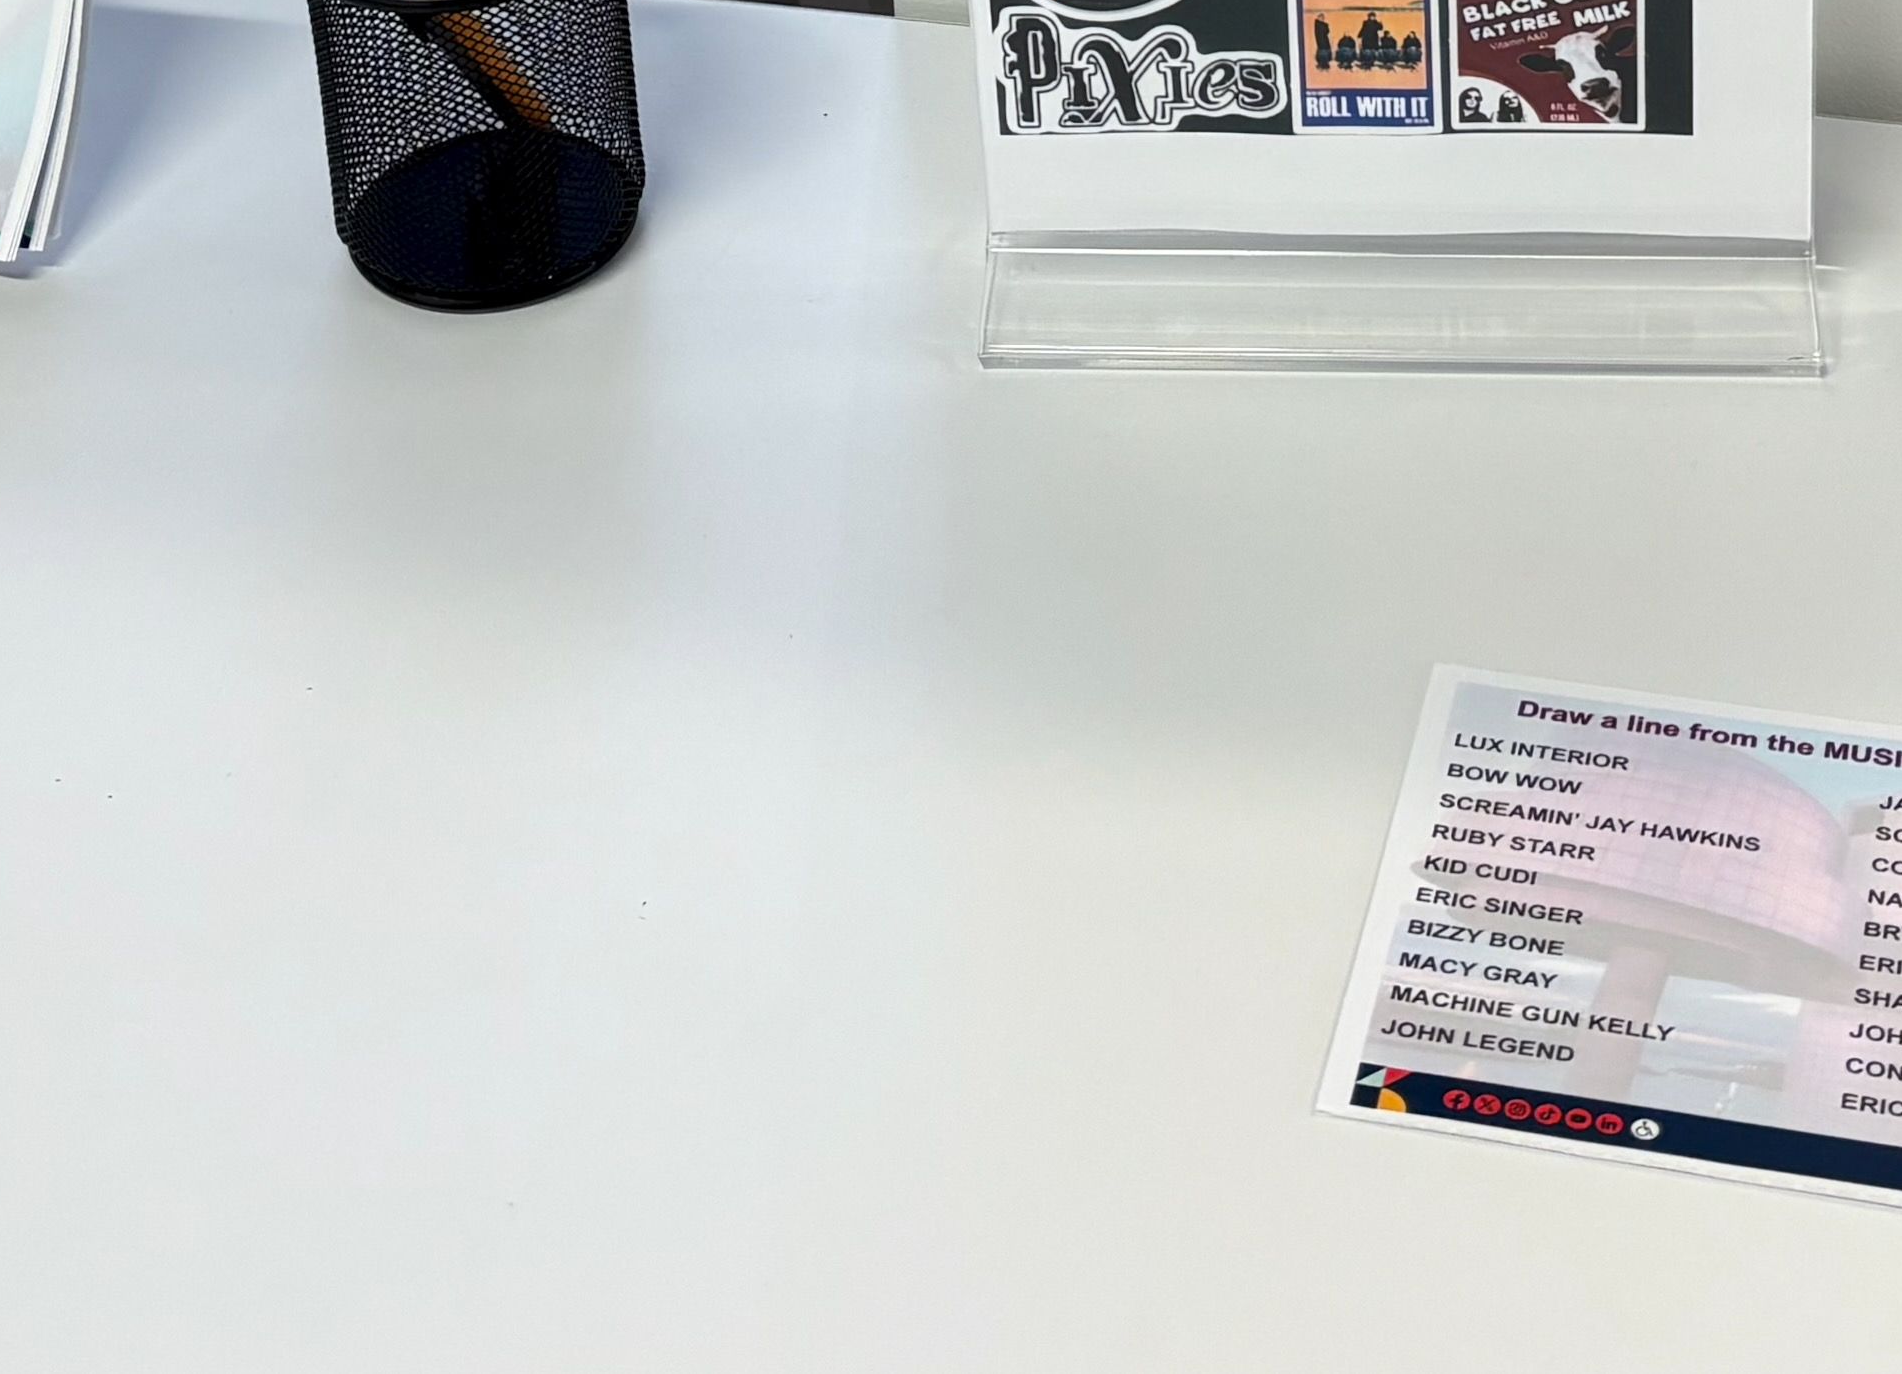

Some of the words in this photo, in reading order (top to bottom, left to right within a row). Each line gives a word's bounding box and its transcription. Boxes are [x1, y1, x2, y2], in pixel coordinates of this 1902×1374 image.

[1470, 21, 1505, 42] FAT
[1509, 10, 1561, 35] FREE
[1571, 1, 1631, 27] MILK
[1305, 96, 1351, 119] ROLL
[1355, 96, 1406, 118] WITH
[1409, 94, 1429, 116] IT
[1517, 700, 1594, 725] Draw
[1601, 716, 1617, 729] a
[1627, 715, 1680, 737] line
[1689, 723, 1757, 748] from
[1767, 735, 1814, 755] the
[1454, 733, 1504, 753] LUX
[1511, 741, 1629, 771] INTERIOR
